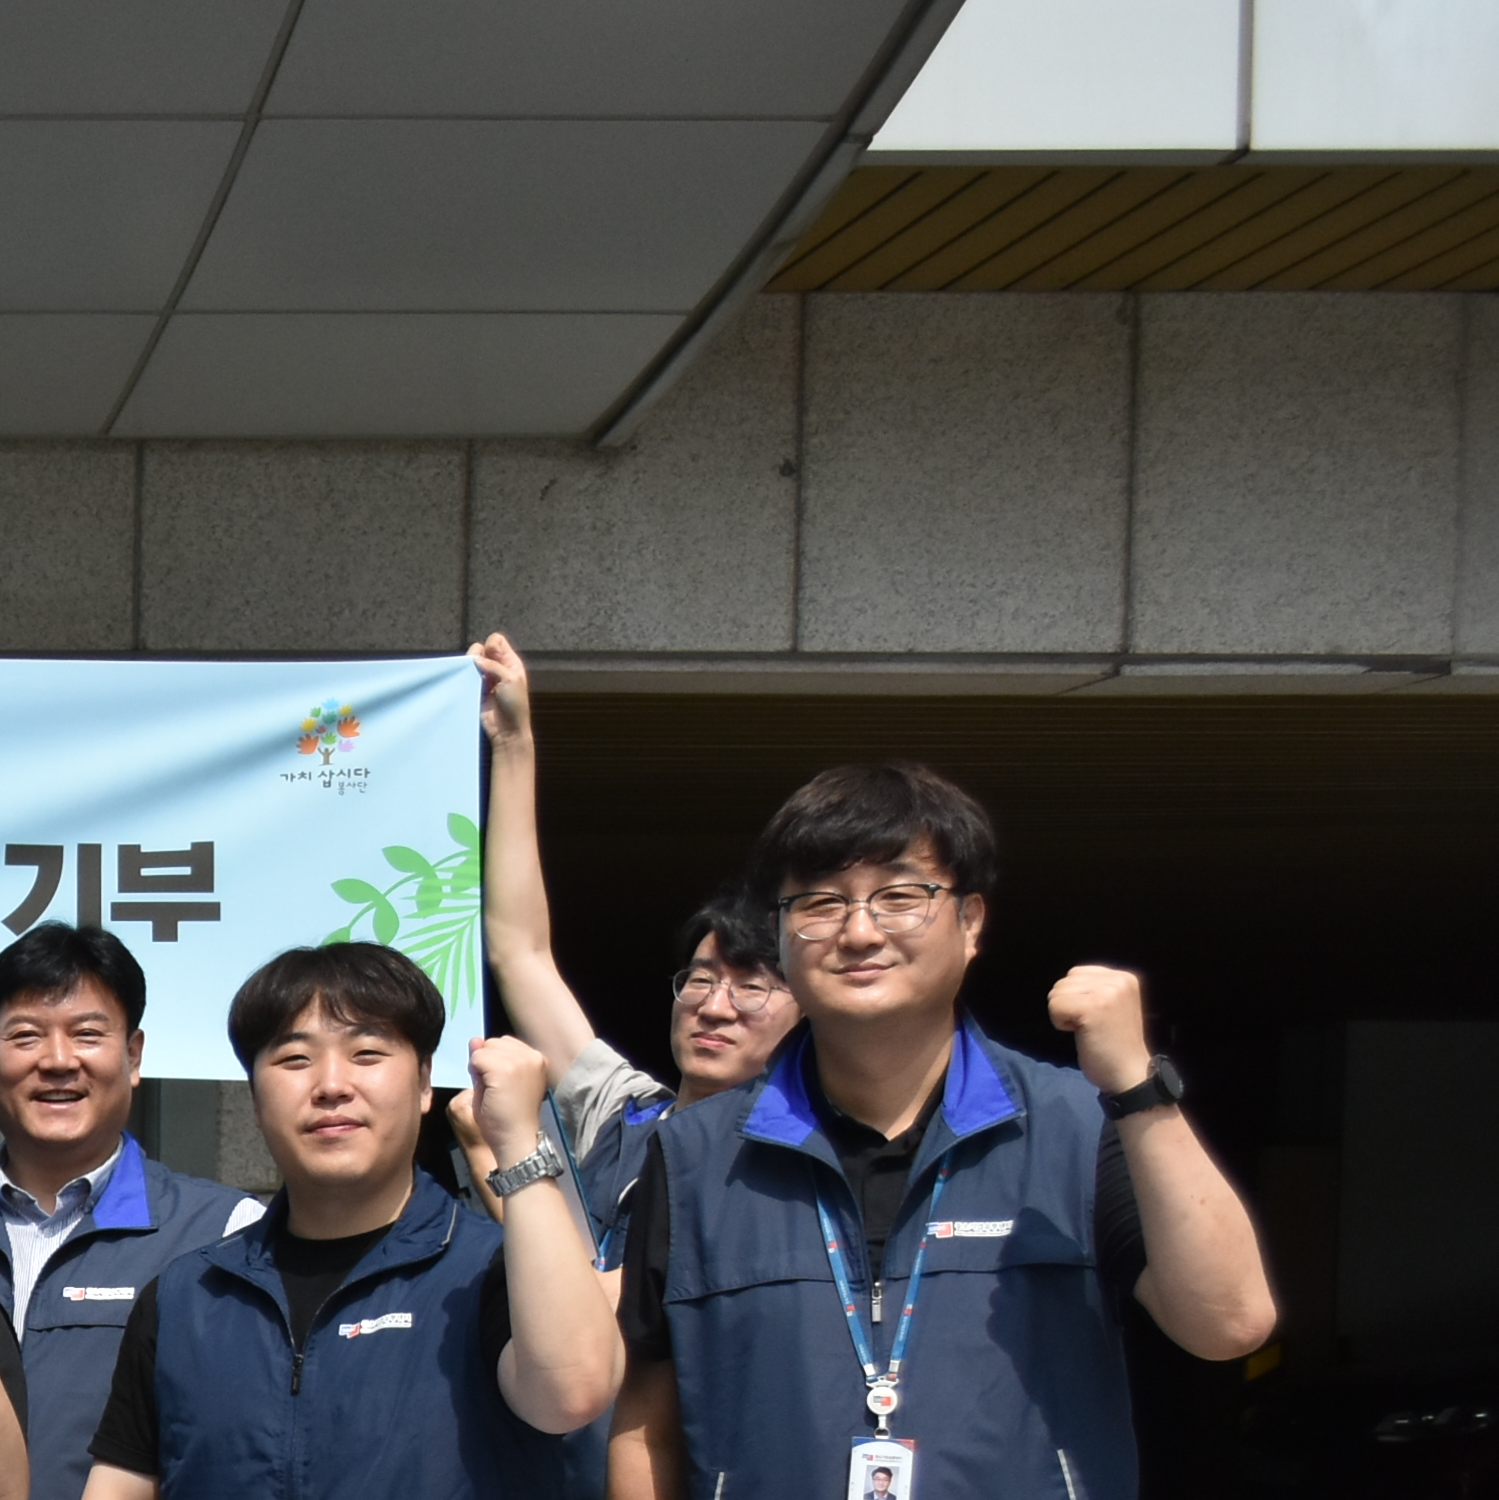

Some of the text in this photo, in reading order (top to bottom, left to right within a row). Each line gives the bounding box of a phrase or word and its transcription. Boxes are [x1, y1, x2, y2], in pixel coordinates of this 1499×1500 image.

[280, 768, 371, 788] 가치 삽시다
[338, 781, 367, 796] 봉사단
[1, 841, 221, 943] 기부
